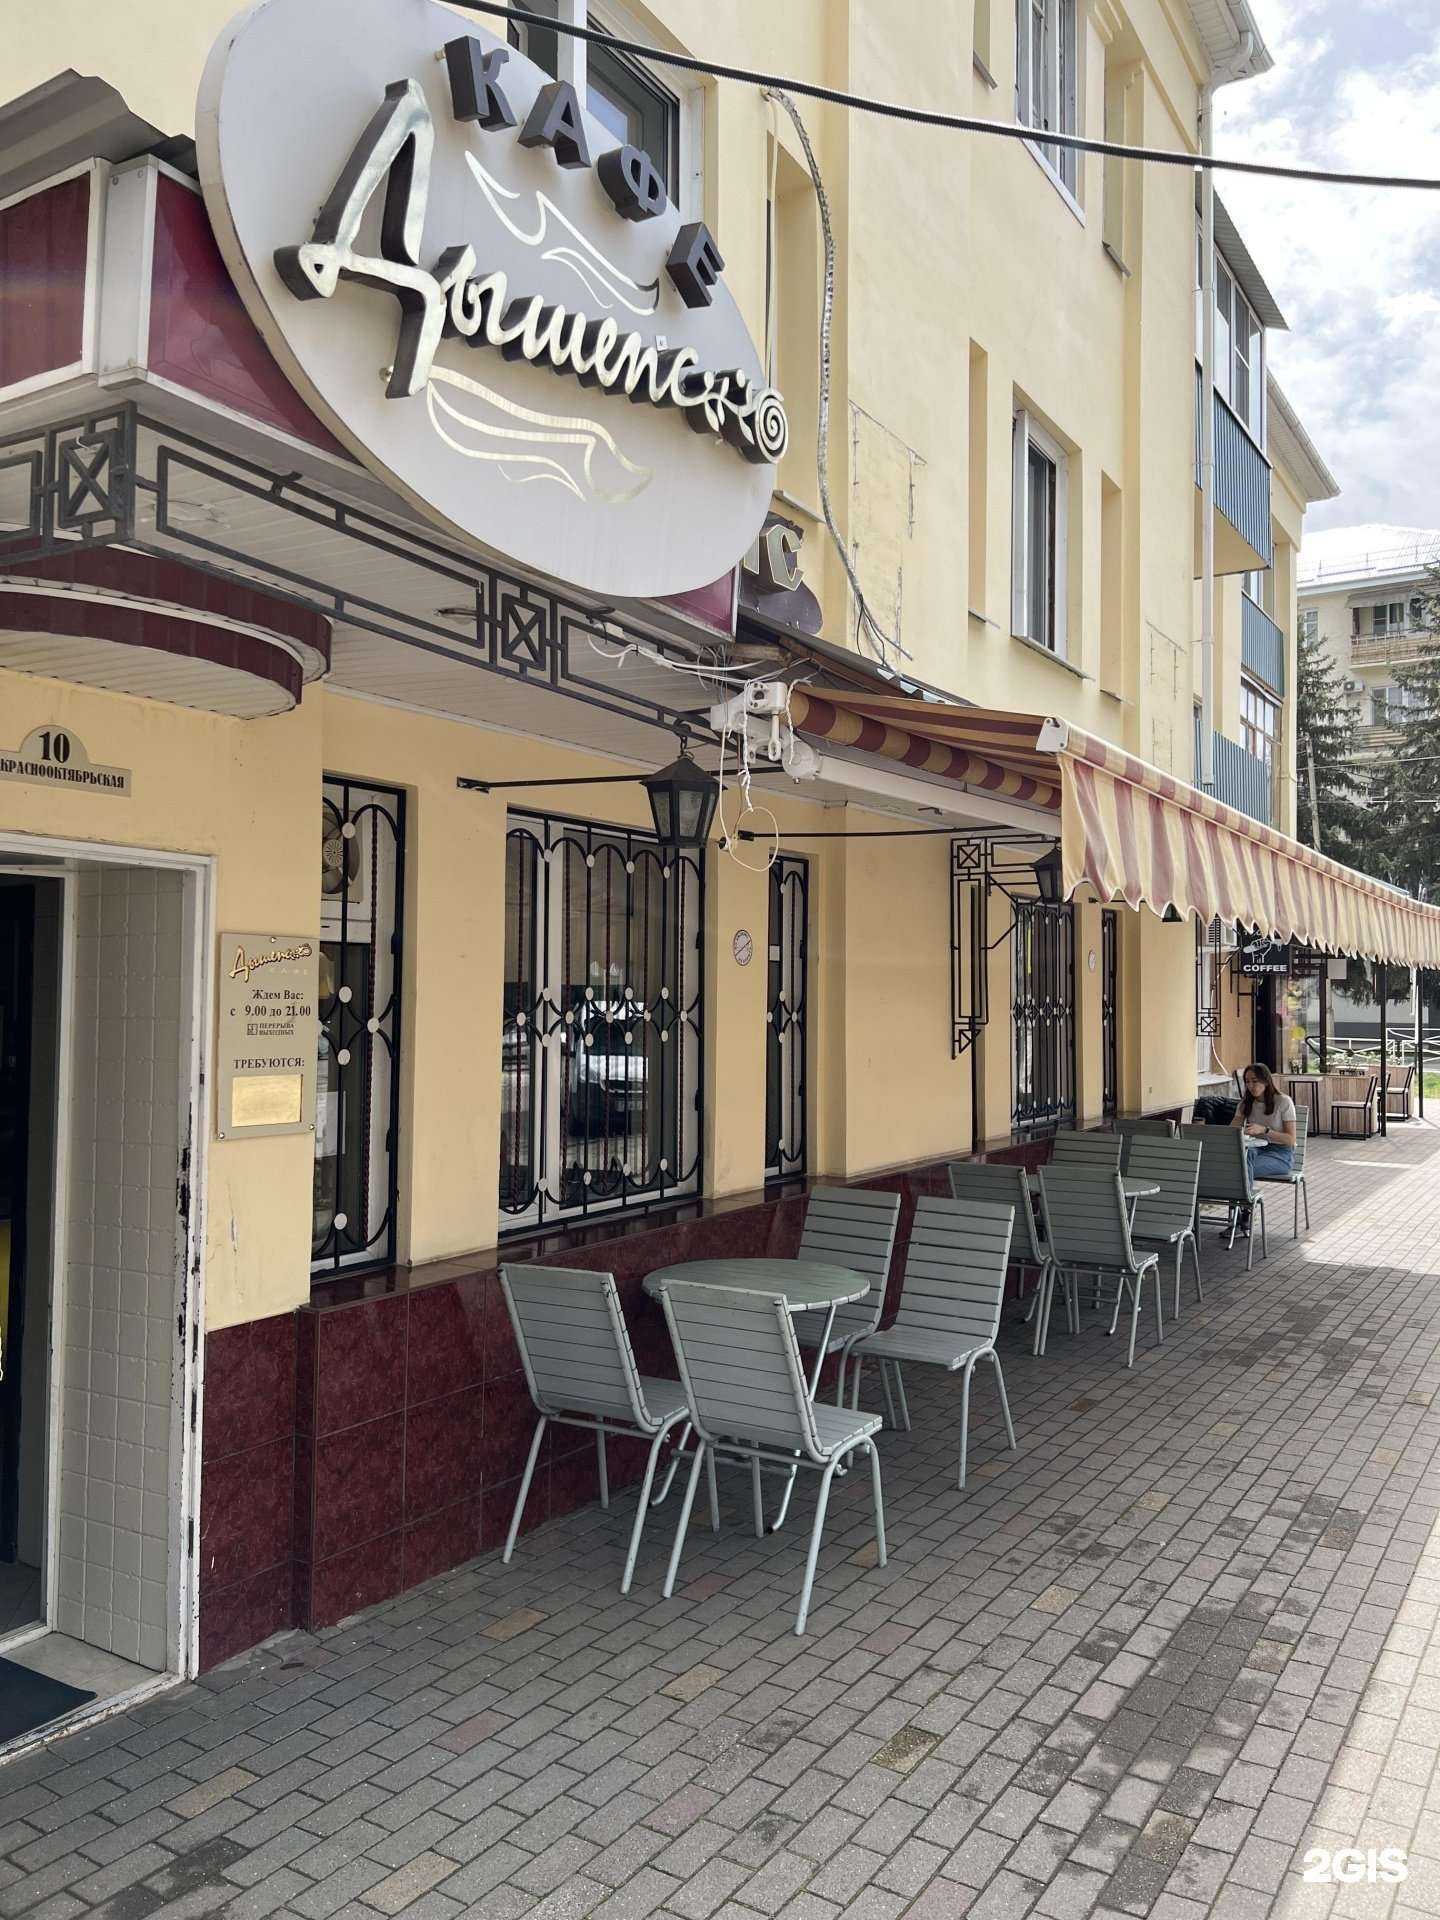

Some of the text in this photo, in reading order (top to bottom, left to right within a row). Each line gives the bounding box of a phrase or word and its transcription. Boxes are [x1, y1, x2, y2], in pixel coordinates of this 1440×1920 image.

[443, 35, 725, 308] КАФЕ
[39, 731, 70, 763] 10
[0, 758, 125, 789] КРАСНООКТЯБРЬСКАЯ
[252, 989, 304, 1000] Ждем Вас:
[230, 1005, 311, 1017] с 9.00 до 21.00
[233, 1057, 305, 1069] ТРЕБУЮТСЯ:
